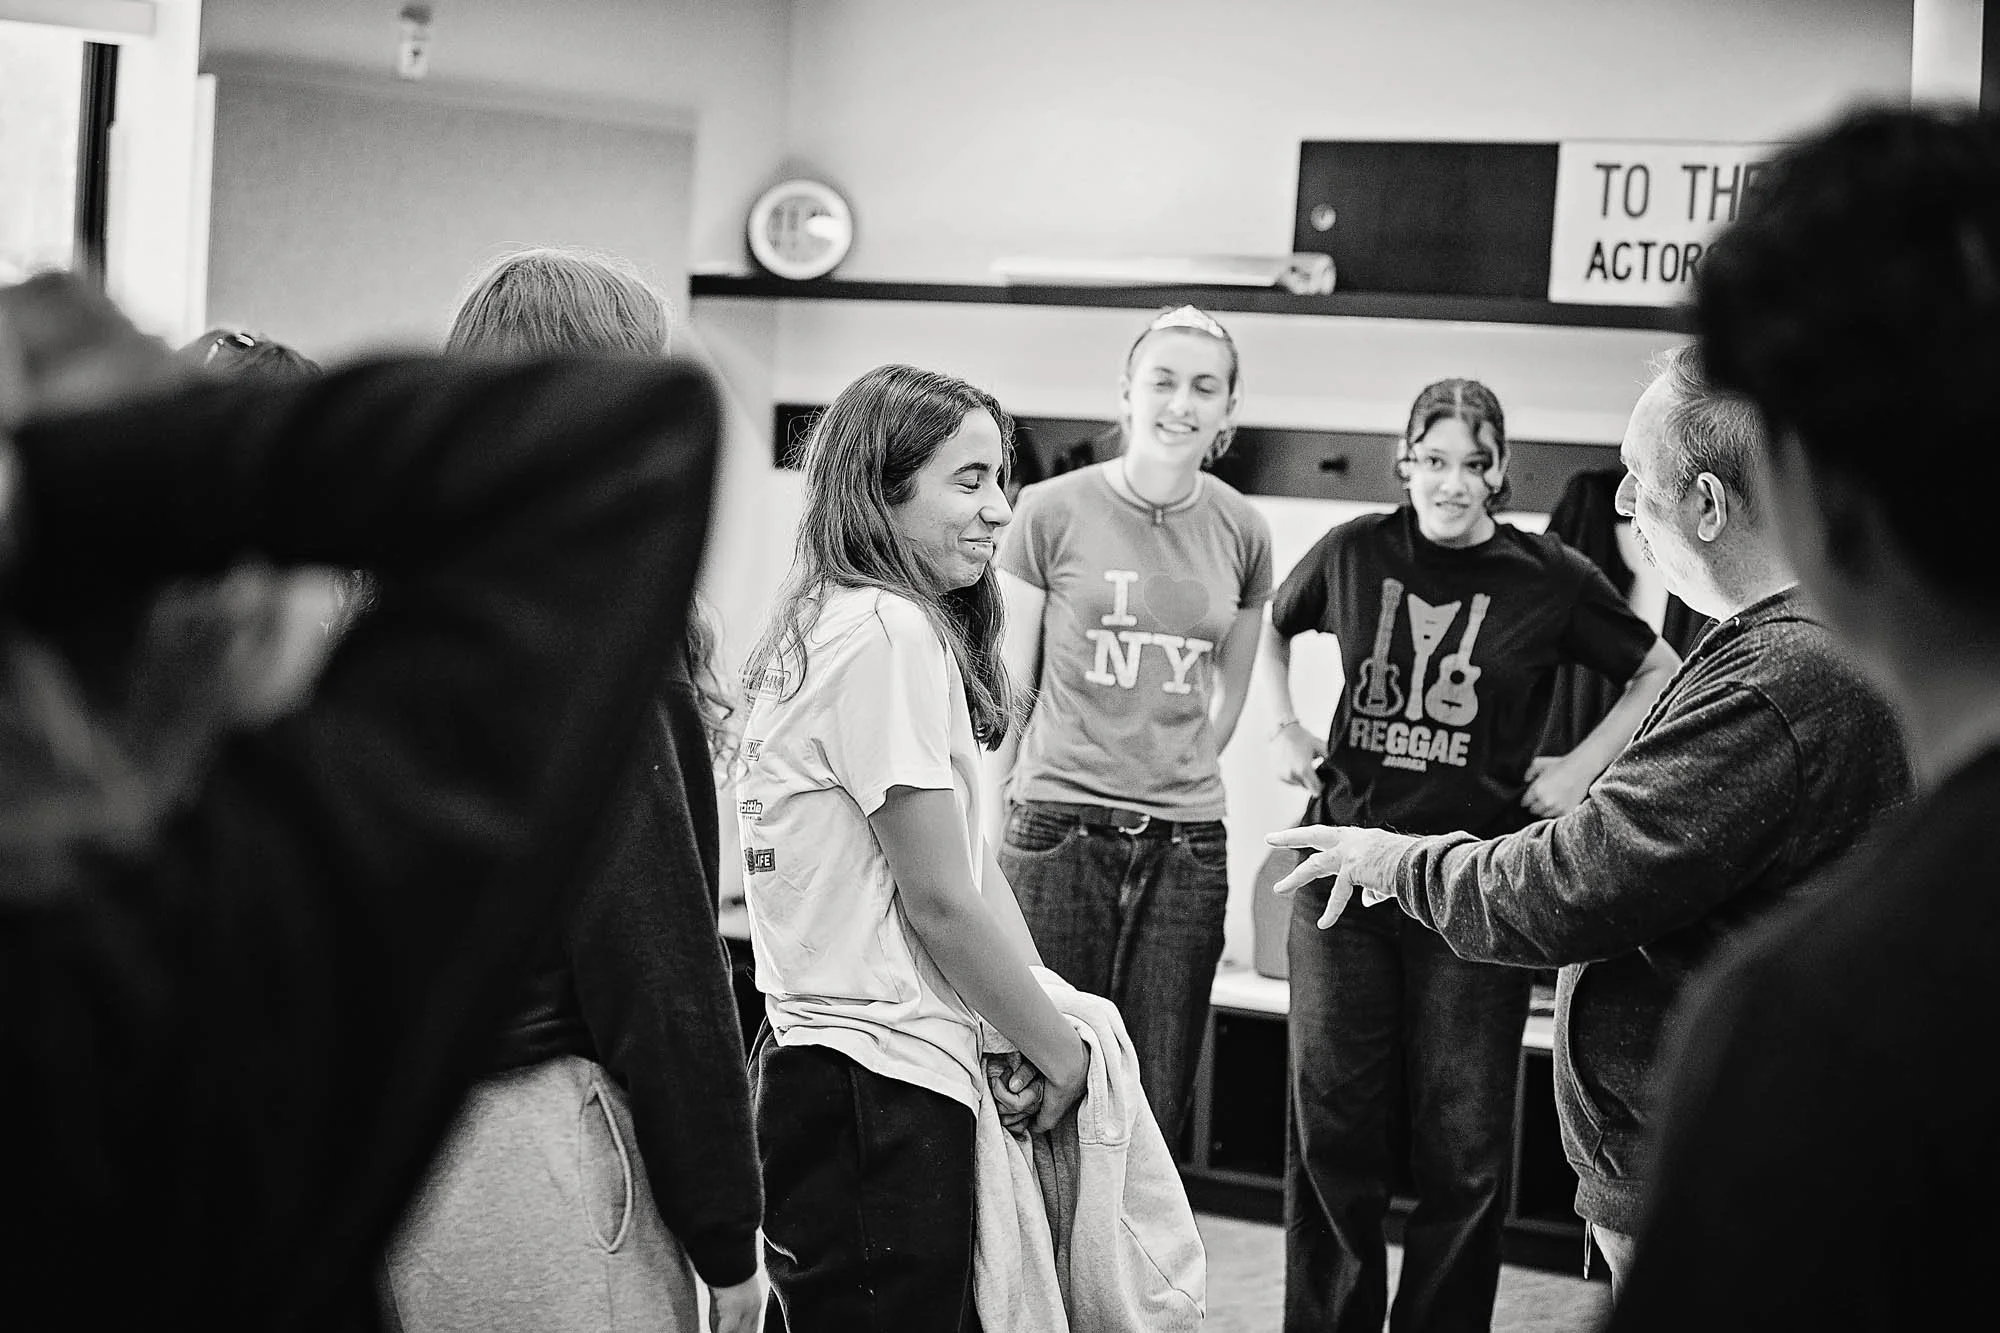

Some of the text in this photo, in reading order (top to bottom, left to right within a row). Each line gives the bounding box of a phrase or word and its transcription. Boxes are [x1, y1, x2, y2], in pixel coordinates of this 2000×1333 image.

[1594, 163, 1650, 219] TO
[1585, 241, 1714, 283] ACTOR
[1101, 569, 1139, 626] I
[1085, 628, 1214, 694] NY
[1350, 716, 1472, 767] REGGAE
